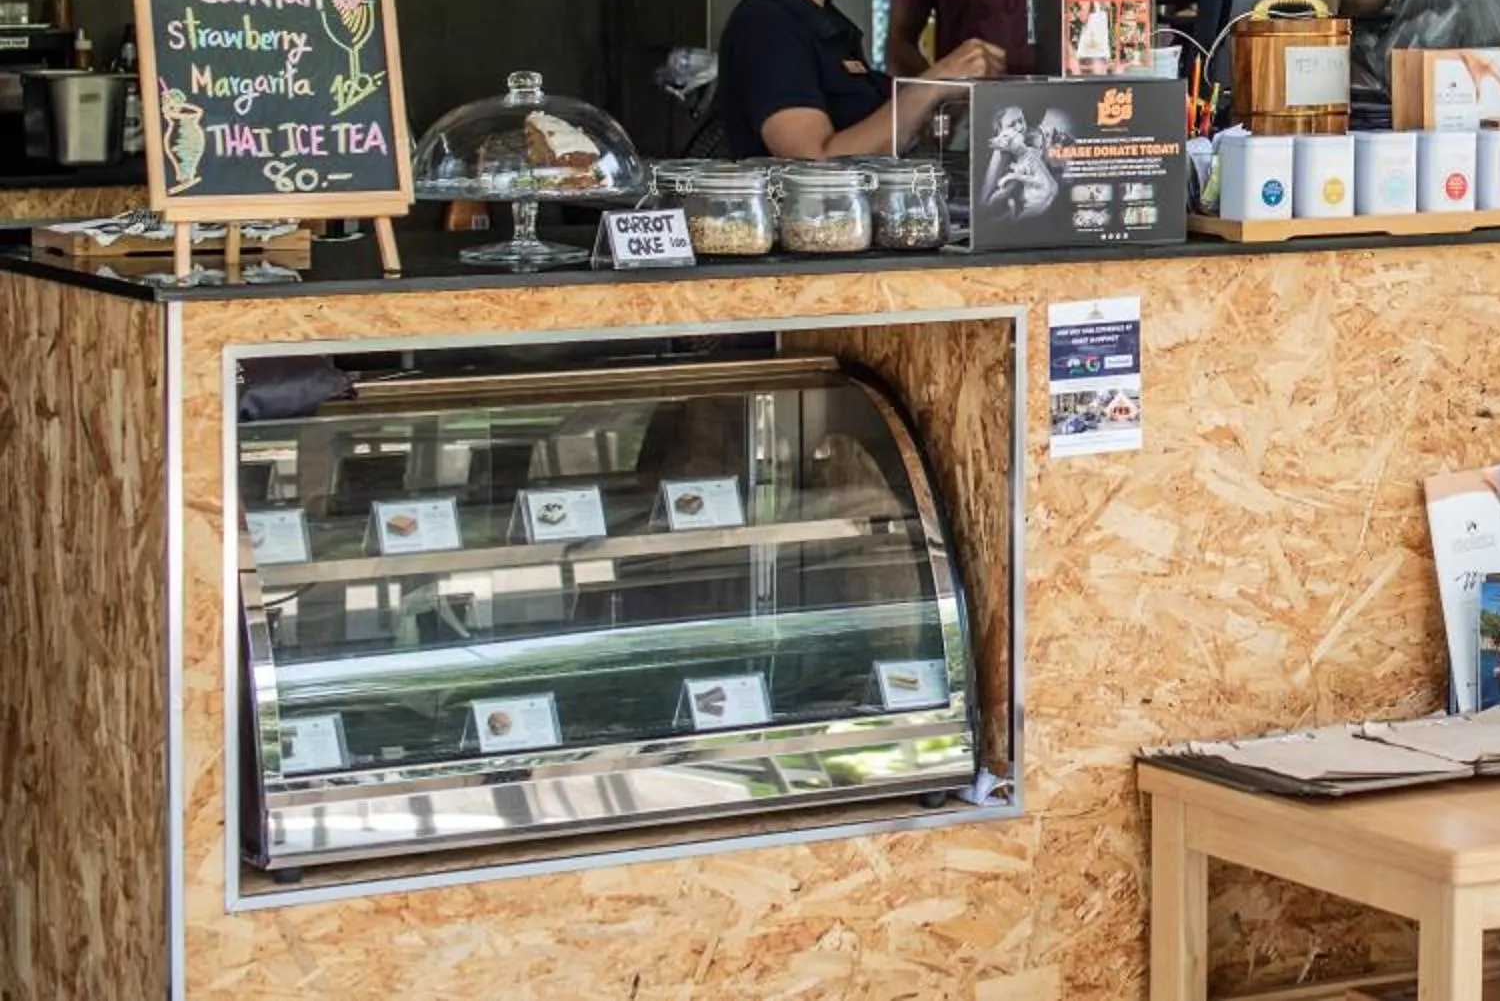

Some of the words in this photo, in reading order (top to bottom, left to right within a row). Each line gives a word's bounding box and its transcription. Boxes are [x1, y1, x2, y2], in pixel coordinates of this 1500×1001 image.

[190, 60, 316, 116] Margarita
[205, 122, 275, 158] THAI
[278, 122, 329, 157] ICE
[331, 120, 388, 156] TEA
[1049, 145, 1093, 159] PLEASE
[1094, 144, 1139, 157] DONATE
[1140, 142, 1180, 155] TODAY!
[615, 214, 675, 233] CARROT
[627, 236, 665, 255] CAKE
